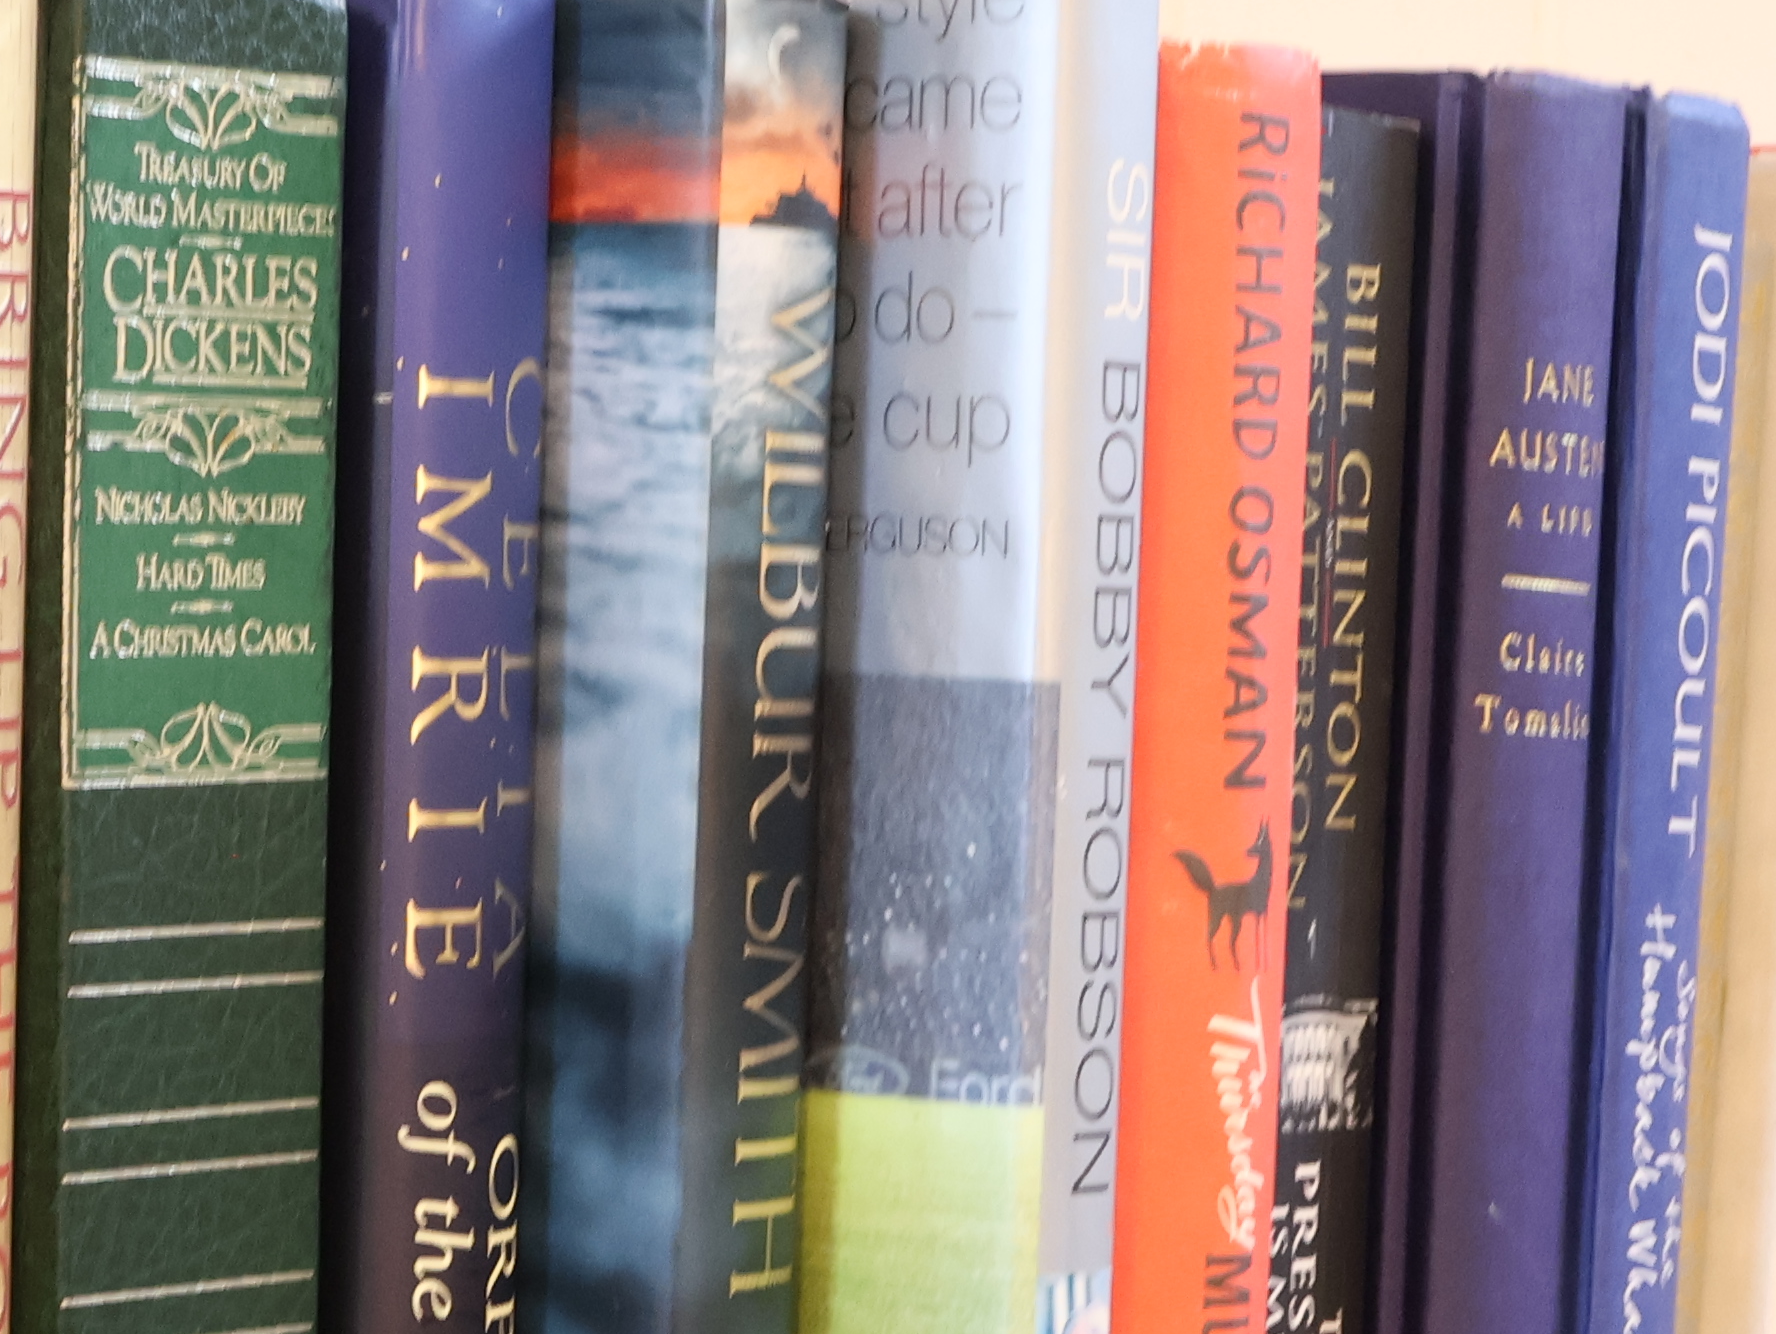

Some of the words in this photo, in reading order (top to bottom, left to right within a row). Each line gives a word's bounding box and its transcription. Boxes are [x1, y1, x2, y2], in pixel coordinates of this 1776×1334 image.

[86, 180, 168, 229] WORLD
[133, 140, 246, 190] TREASURY
[877, 162, 1024, 242] after
[103, 244, 318, 314] CHARLES
[1103, 156, 1150, 324] SIR
[112, 312, 312, 384] DICKENS
[874, 269, 956, 345] do
[1337, 262, 1382, 427] BILL
[1690, 222, 1735, 427] JODI
[1522, 357, 1596, 407] JANE
[881, 388, 1011, 468] cup
[95, 484, 204, 526] NICHOLAS
[207, 485, 307, 526] NICKLEBY
[826, 511, 1011, 559] ERGUSON
[1087, 359, 1142, 720] BOBBY
[1505, 503, 1524, 533] A
[136, 552, 204, 592] HARD
[204, 552, 267, 591] TIMES
[749, 267, 837, 843] WILBUR
[89, 619, 112, 660] A
[113, 618, 238, 660] CHRISTMAS
[240, 617, 317, 658] CAROL
[404, 363, 496, 980] IMRIE
[1222, 484, 1274, 792] OSMAN
[1325, 451, 1374, 833] CLINTON
[1498, 630, 1586, 679] Claire
[1668, 455, 1723, 860] PICOULT
[1070, 756, 1129, 1197] ROBSON
[728, 873, 807, 1299] SMITH
[1626, 902, 1677, 1210] Humpback
[397, 1079, 476, 1175] of
[1206, 974, 1268, 1251] Thursday
[410, 1197, 477, 1323] the
[1267, 1202, 1291, 1265] IS
